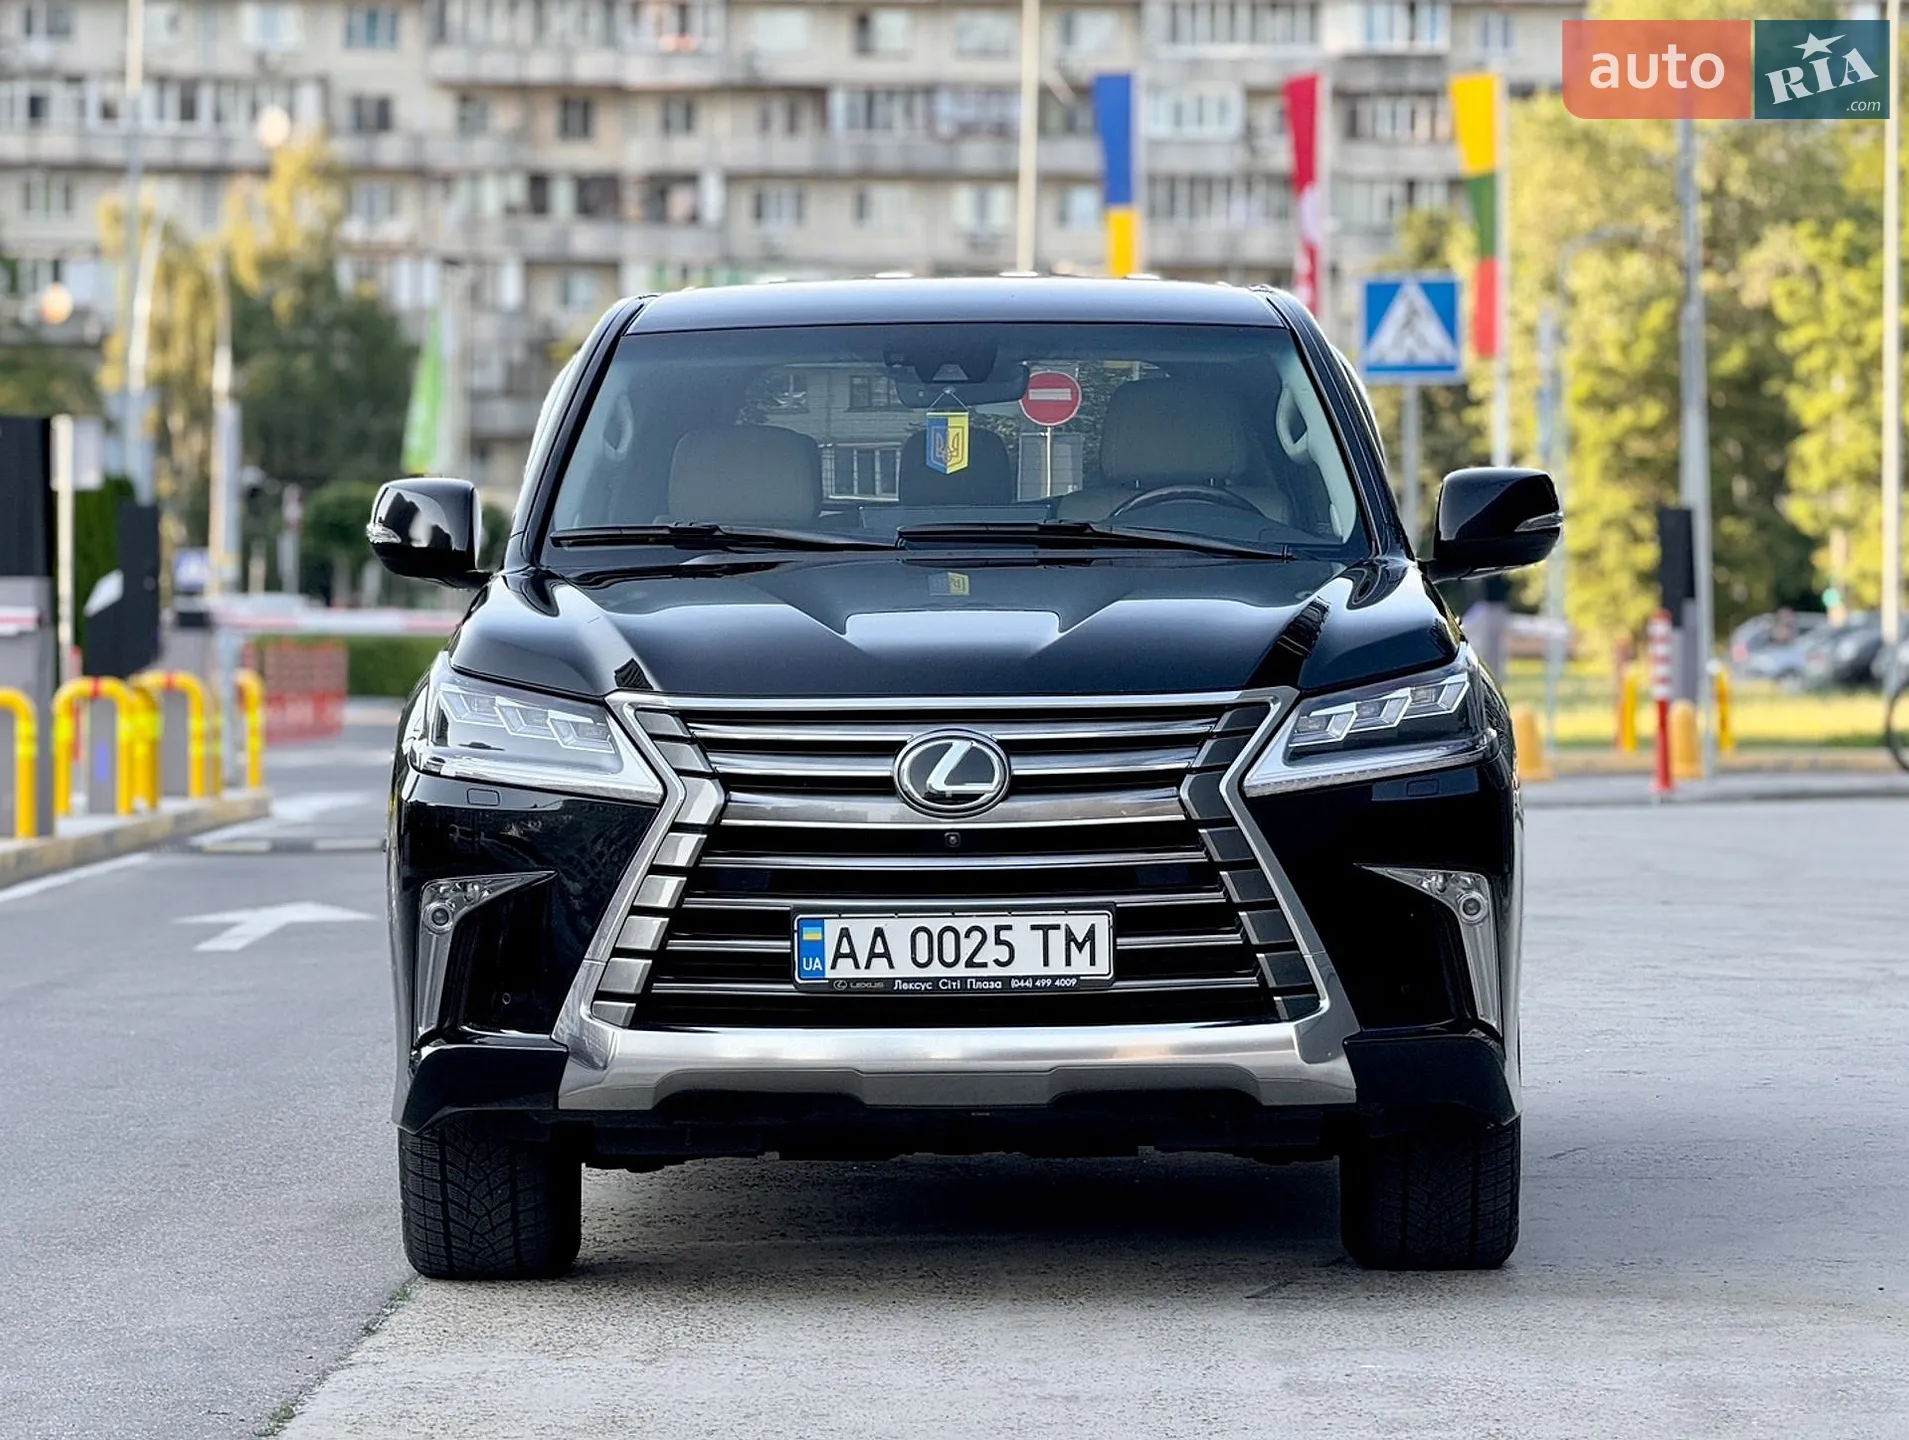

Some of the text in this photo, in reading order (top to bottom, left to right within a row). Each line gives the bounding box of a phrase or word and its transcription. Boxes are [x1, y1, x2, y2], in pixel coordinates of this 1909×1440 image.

[830, 923, 1096, 970] AA 0025 TM
[802, 959, 823, 971] UA
[849, 981, 885, 990] LEXUS
[893, 976, 1078, 990] Лексус Сіті Плаза (044) 499 4009
